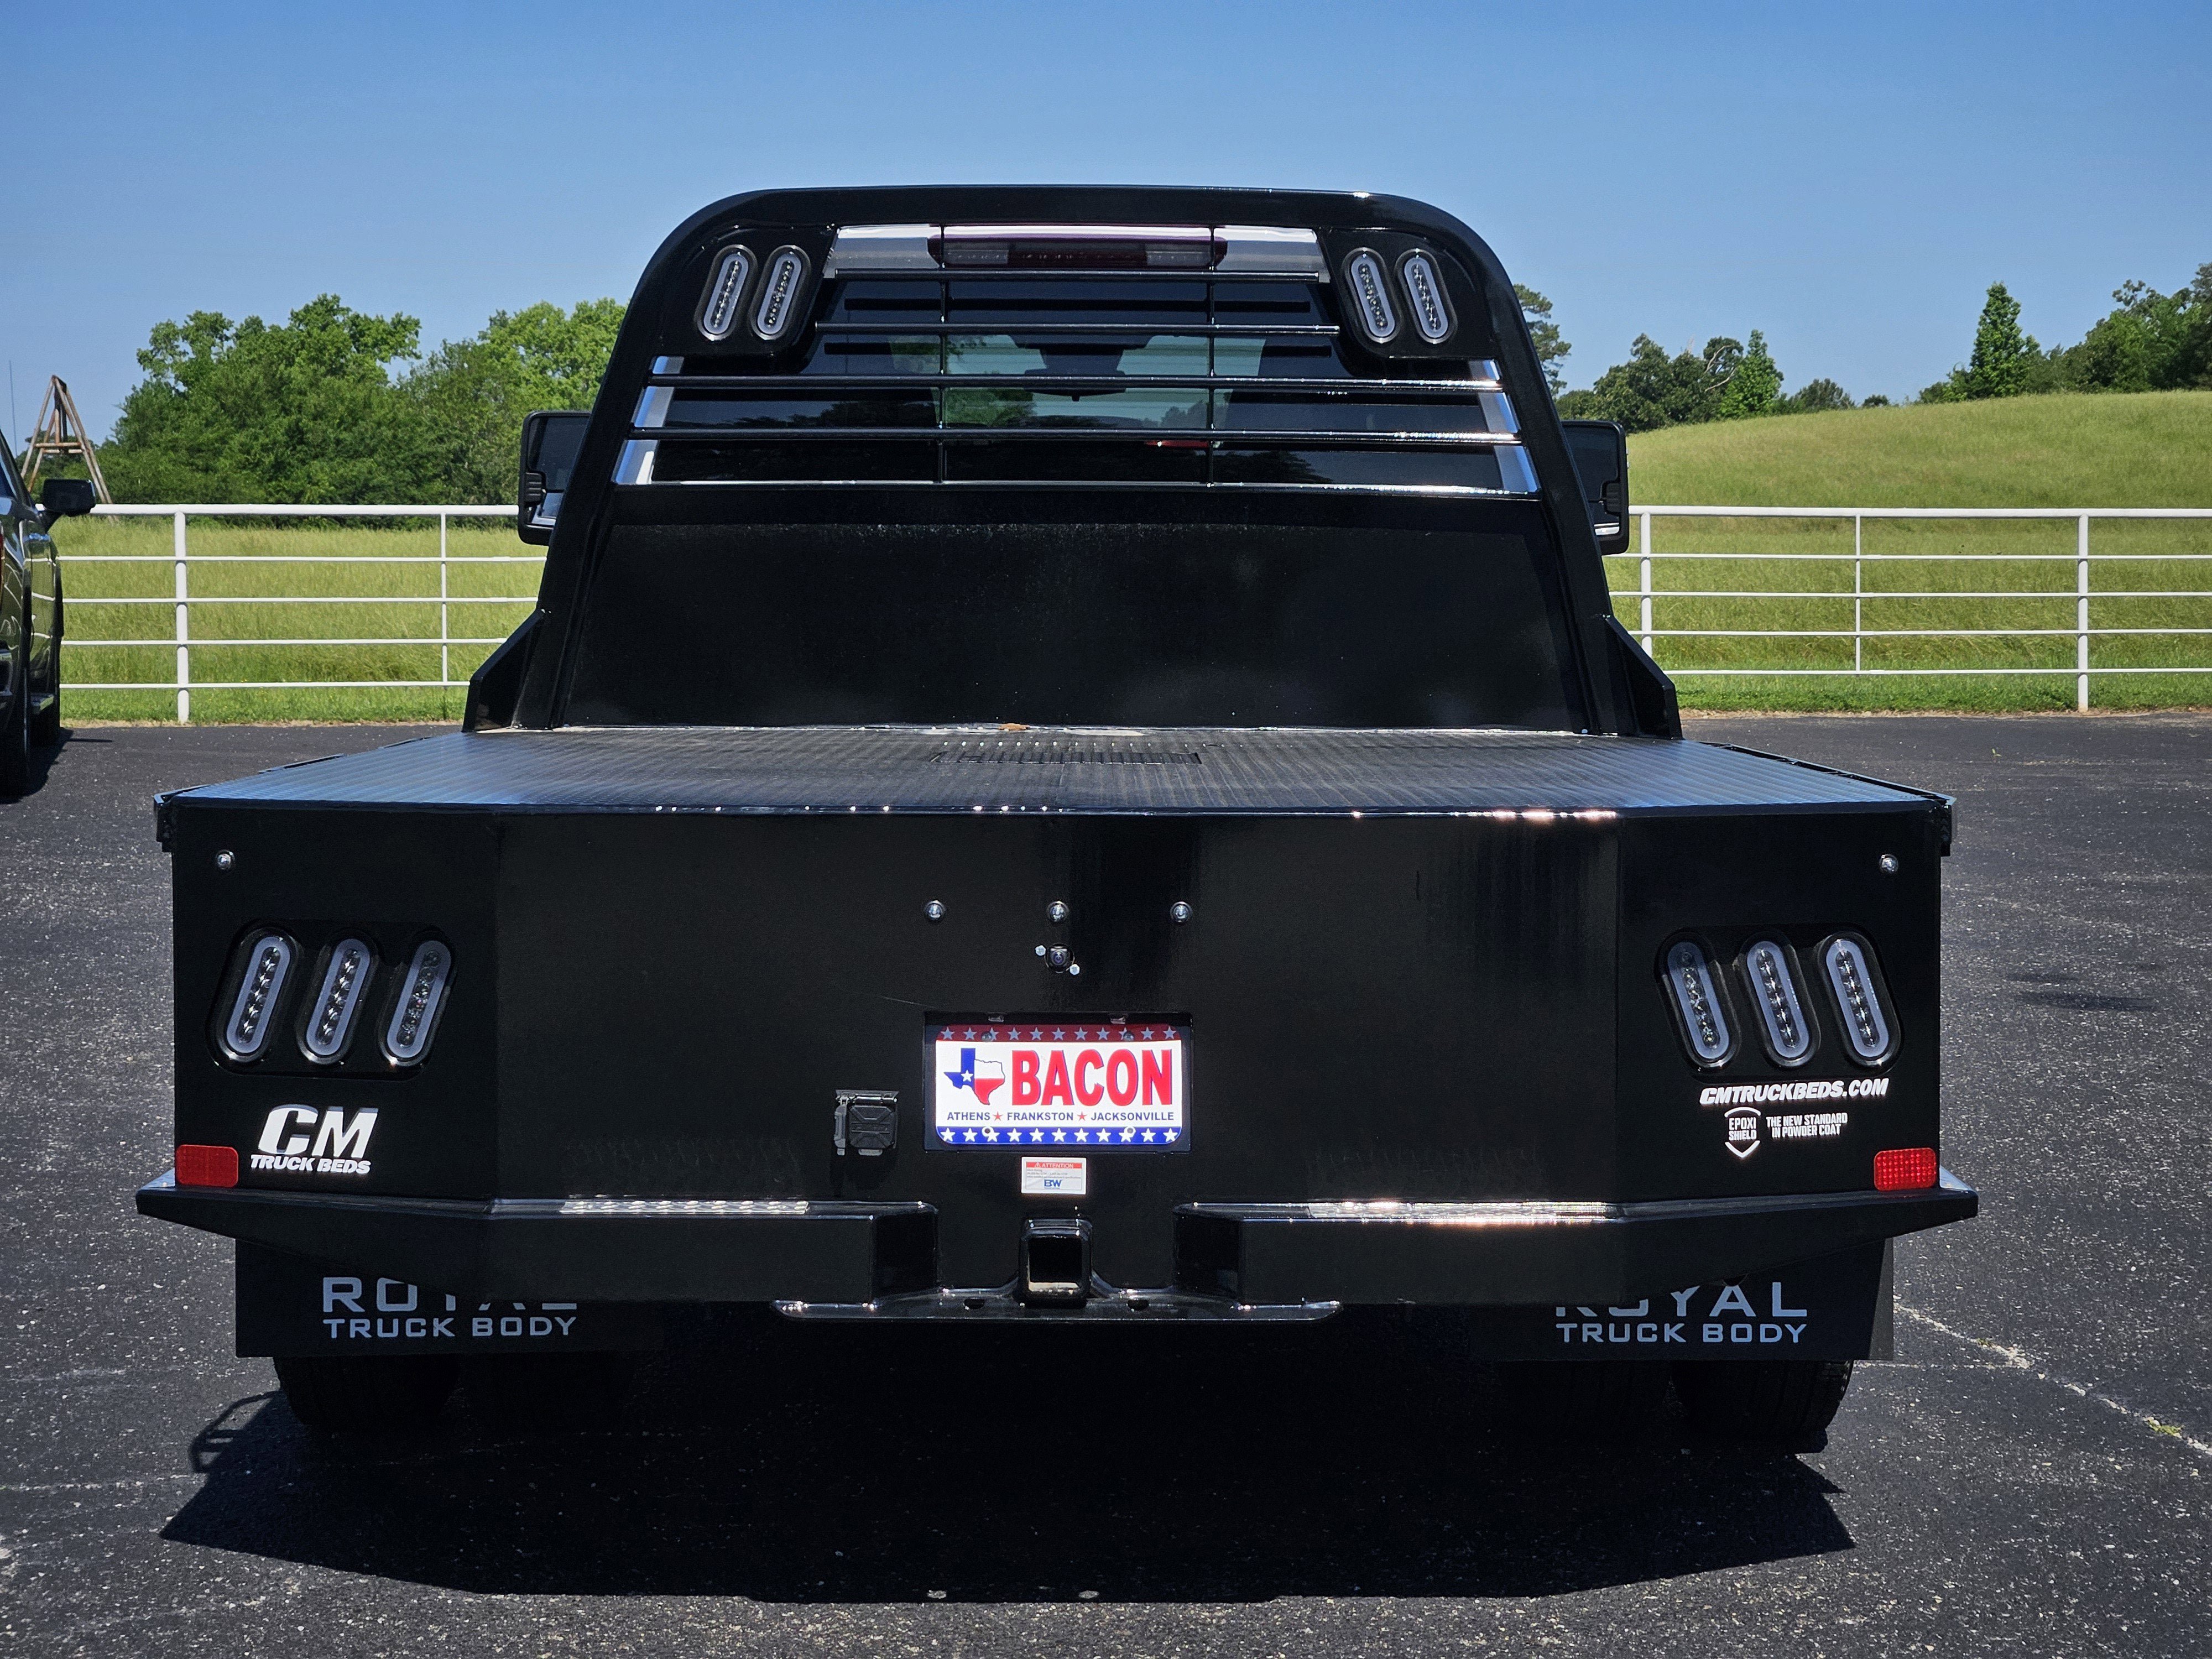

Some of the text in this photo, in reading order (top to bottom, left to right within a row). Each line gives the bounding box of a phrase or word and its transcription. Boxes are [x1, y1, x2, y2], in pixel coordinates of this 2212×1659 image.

[1012, 1049, 1172, 1107] BACON
[1699, 1078, 1889, 1105] CMTRUCKBEDS.COM
[947, 1112, 1174, 1121] ATHENS FRANKSTON JACKSONVILLE
[1729, 1117, 1756, 1130] EPOXI
[1766, 1113, 1848, 1128] THE NEW STANDARD
[258, 1104, 379, 1159] CM
[1729, 1129, 1757, 1140] SHIELD
[1772, 1123, 1841, 1138] IN POWDER COAT
[251, 1155, 372, 1175] TRUCK BEDS
[1556, 1281, 1807, 1317] YAL
[322, 1317, 577, 1339] TRUCK BODY
[1556, 1323, 1807, 1343] TRUCK BODY
